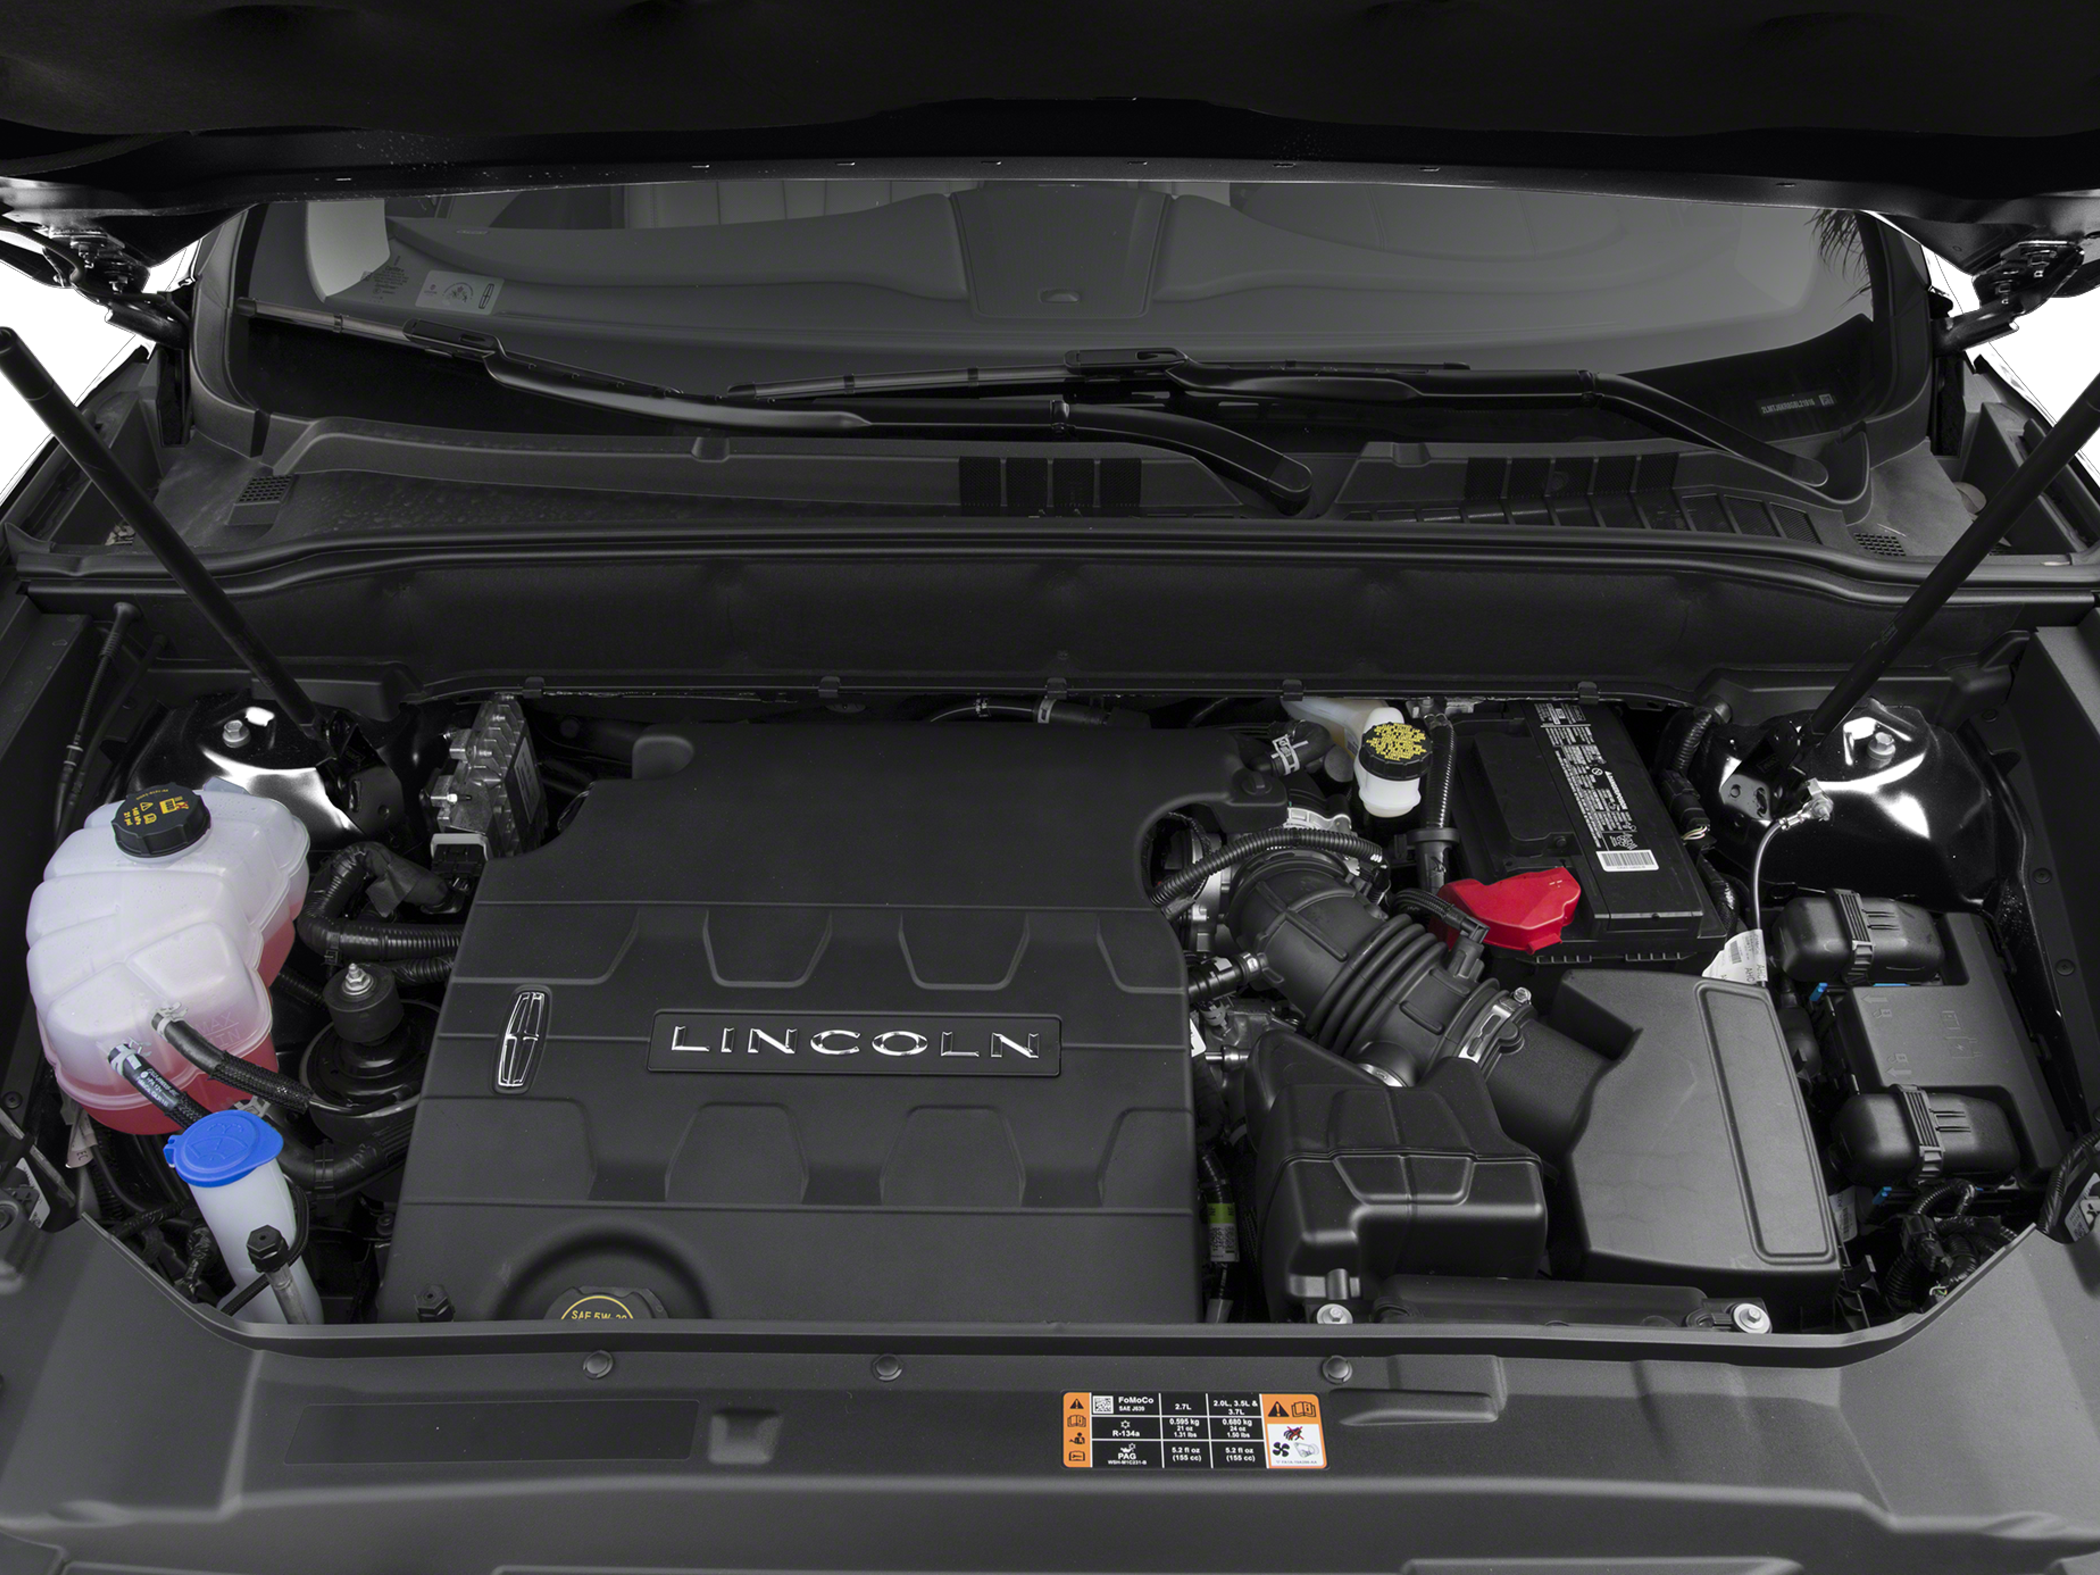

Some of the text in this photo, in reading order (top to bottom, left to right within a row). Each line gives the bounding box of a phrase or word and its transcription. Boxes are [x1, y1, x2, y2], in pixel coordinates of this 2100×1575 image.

[671, 1025, 1040, 1059] LINCOLN
[571, 1309, 592, 1320] SAE
[1118, 1396, 1154, 1404] FoMoCo
[1213, 1400, 1232, 1408] 2.0L,
[1169, 1417, 1200, 1427] 0.595 kg
[1222, 1418, 1253, 1427] 0.680 kg
[1172, 1454, 1202, 1462] (155 cc)
[1225, 1454, 1256, 1462] (155 cc)
